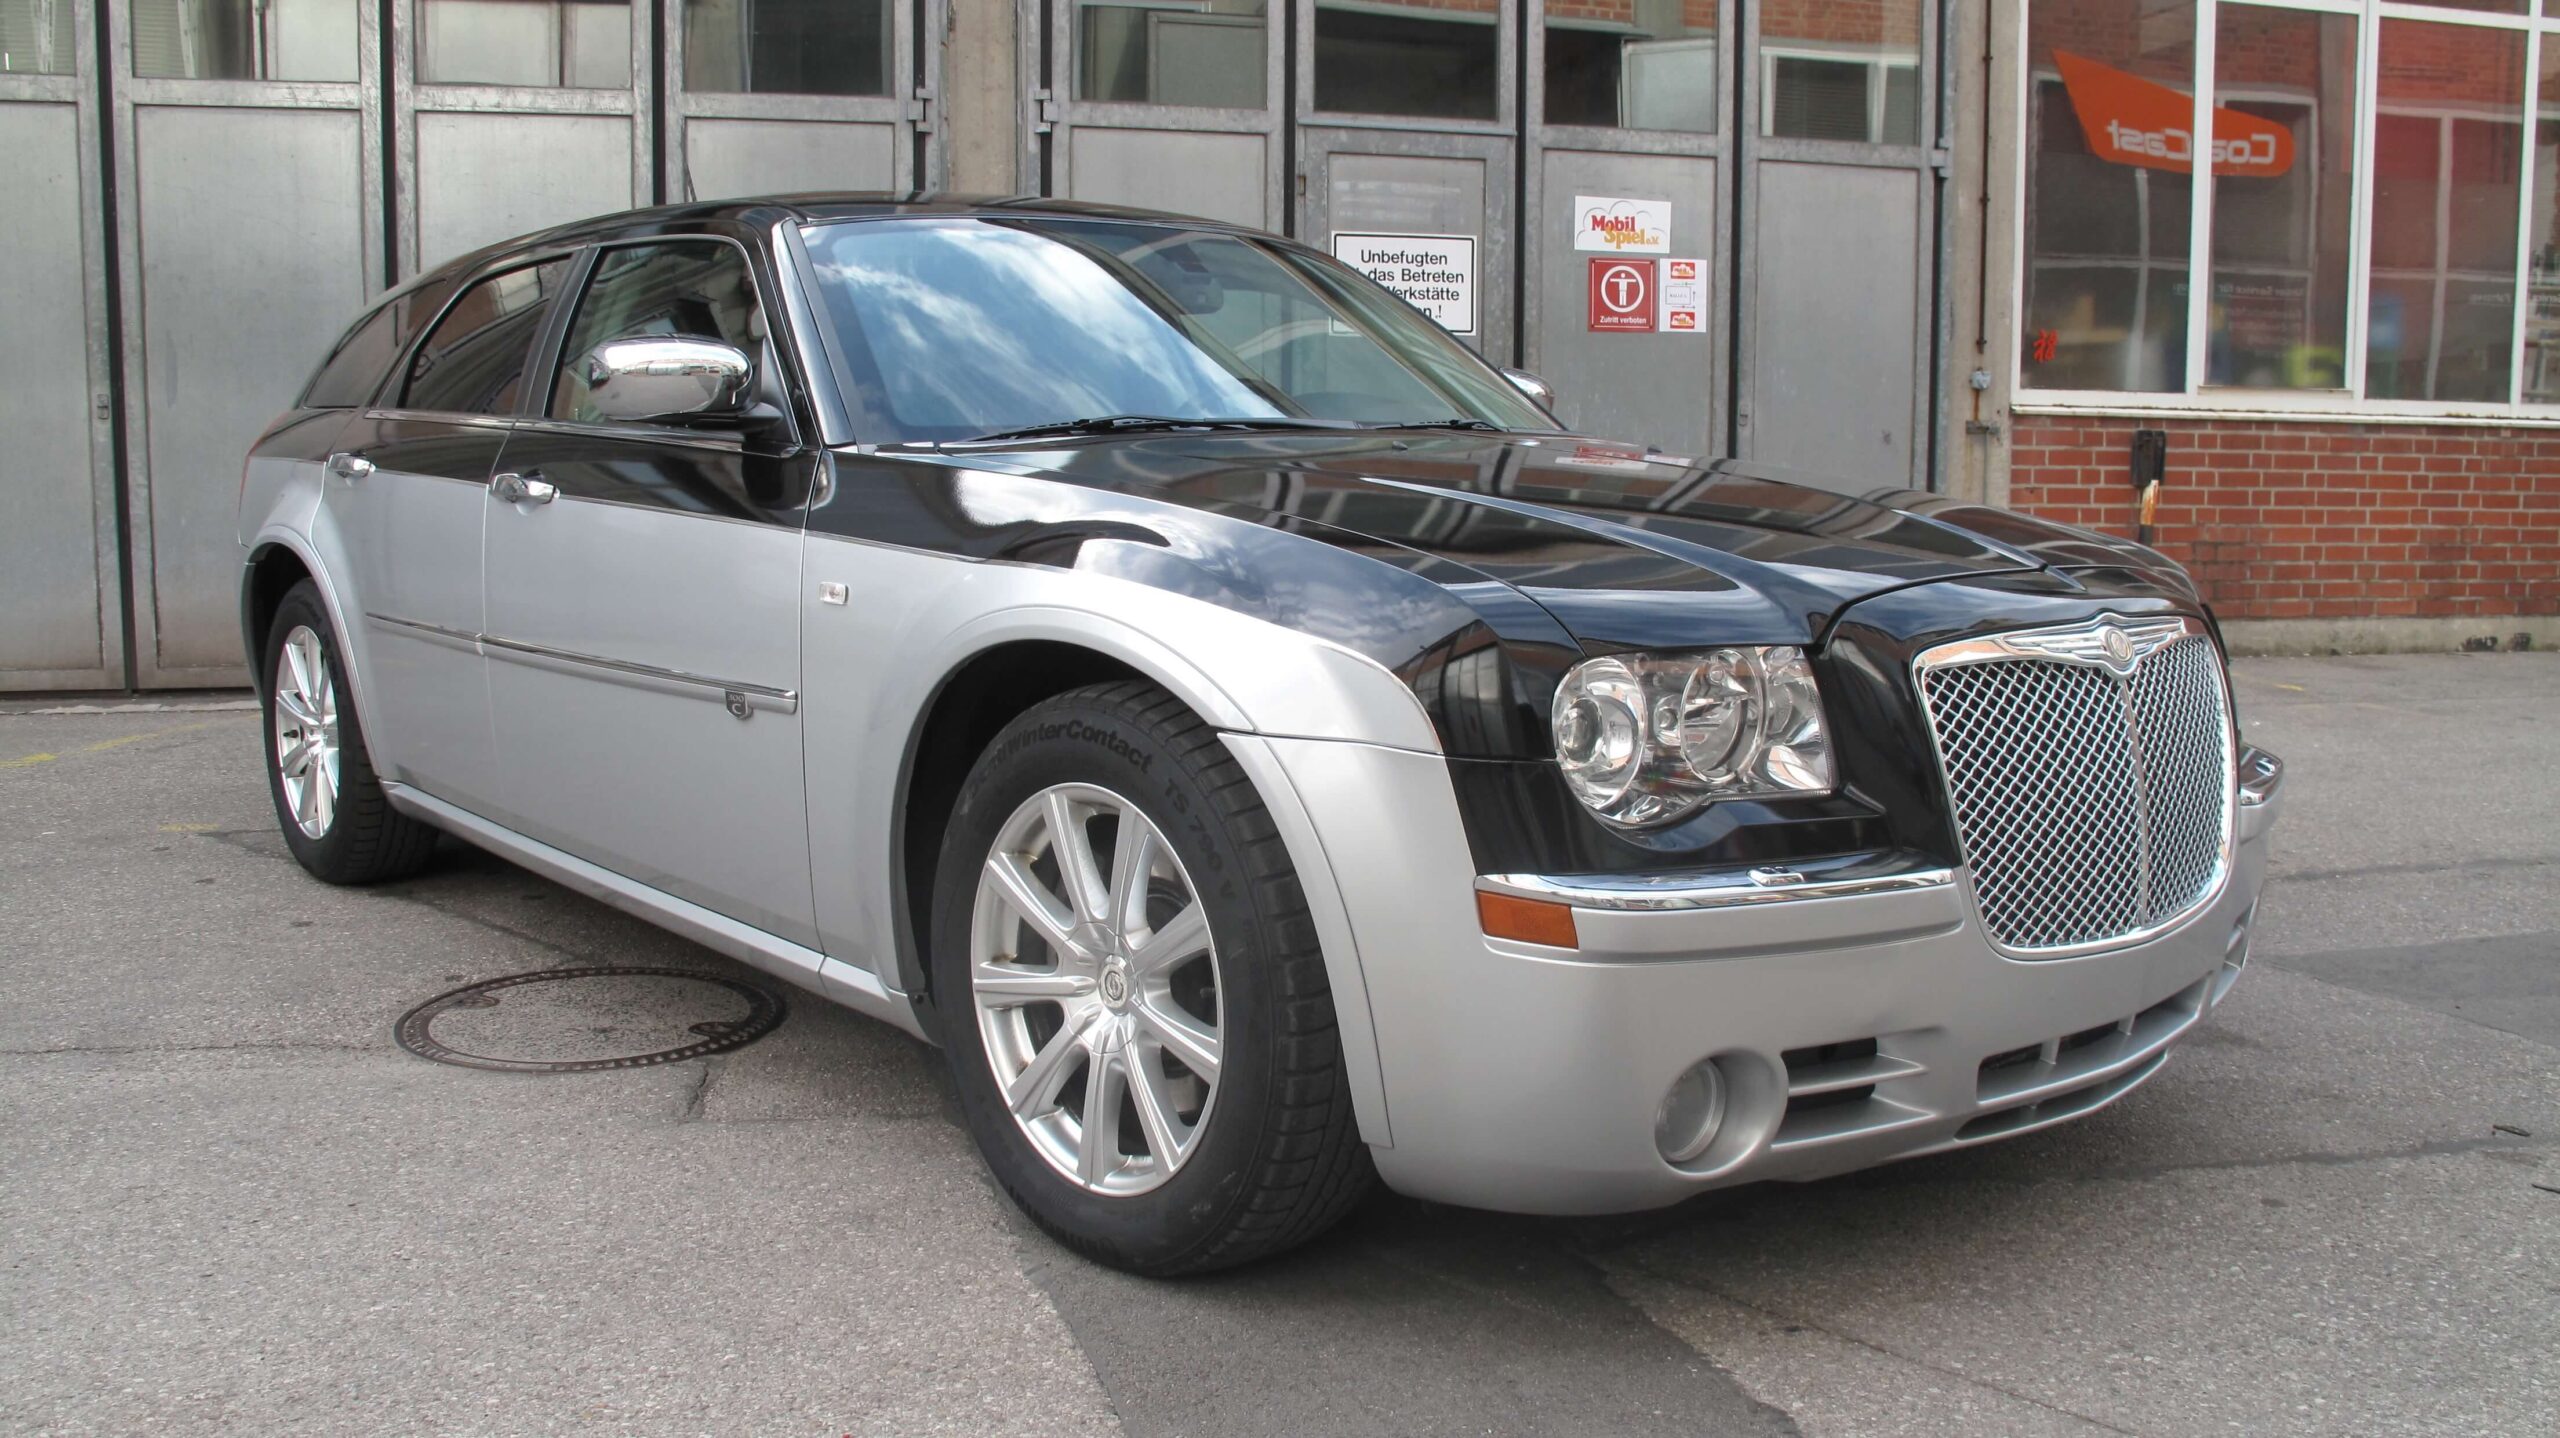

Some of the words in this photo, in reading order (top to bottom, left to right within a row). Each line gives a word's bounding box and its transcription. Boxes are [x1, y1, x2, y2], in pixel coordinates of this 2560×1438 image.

[1591, 215, 1636, 232] Mobil
[1604, 226, 1646, 249] Spiel
[1360, 249, 1448, 267] Unbefugten
[1367, 268, 1395, 282] das
[1401, 268, 1464, 283] Betreten
[1599, 315, 1619, 323] Zutritt
[1619, 316, 1647, 325] verboten
[727, 694, 744, 702] 300
[732, 703, 741, 715] C
[1164, 776, 1190, 815] TS
